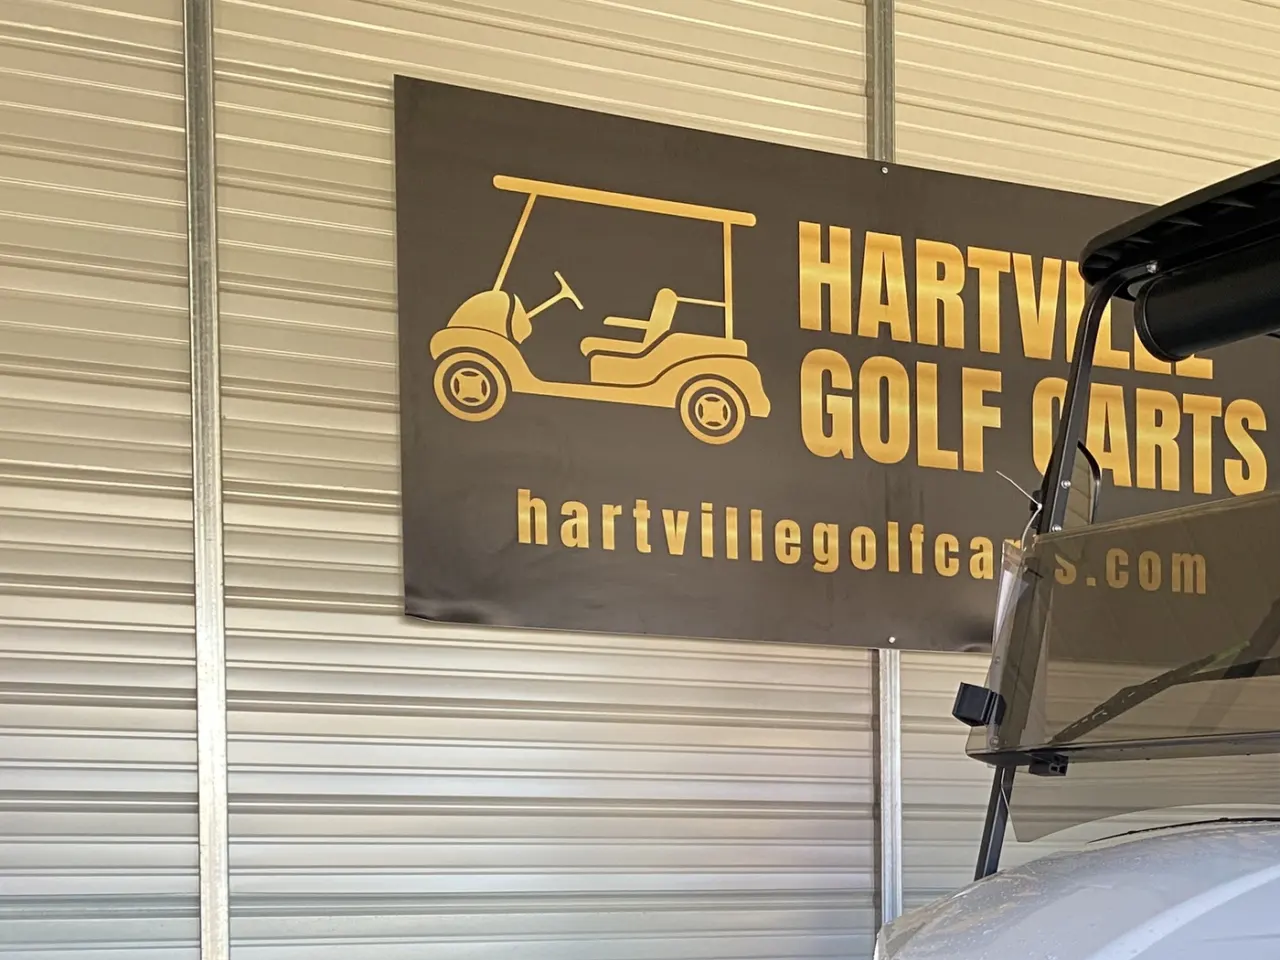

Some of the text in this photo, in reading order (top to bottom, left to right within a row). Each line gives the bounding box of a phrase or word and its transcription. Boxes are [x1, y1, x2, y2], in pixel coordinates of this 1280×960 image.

[798, 220, 1213, 380] HARTVIL
[800, 348, 1268, 496] GOLF CARTS
[517, 488, 1207, 595] hartvillegolfcas.com
